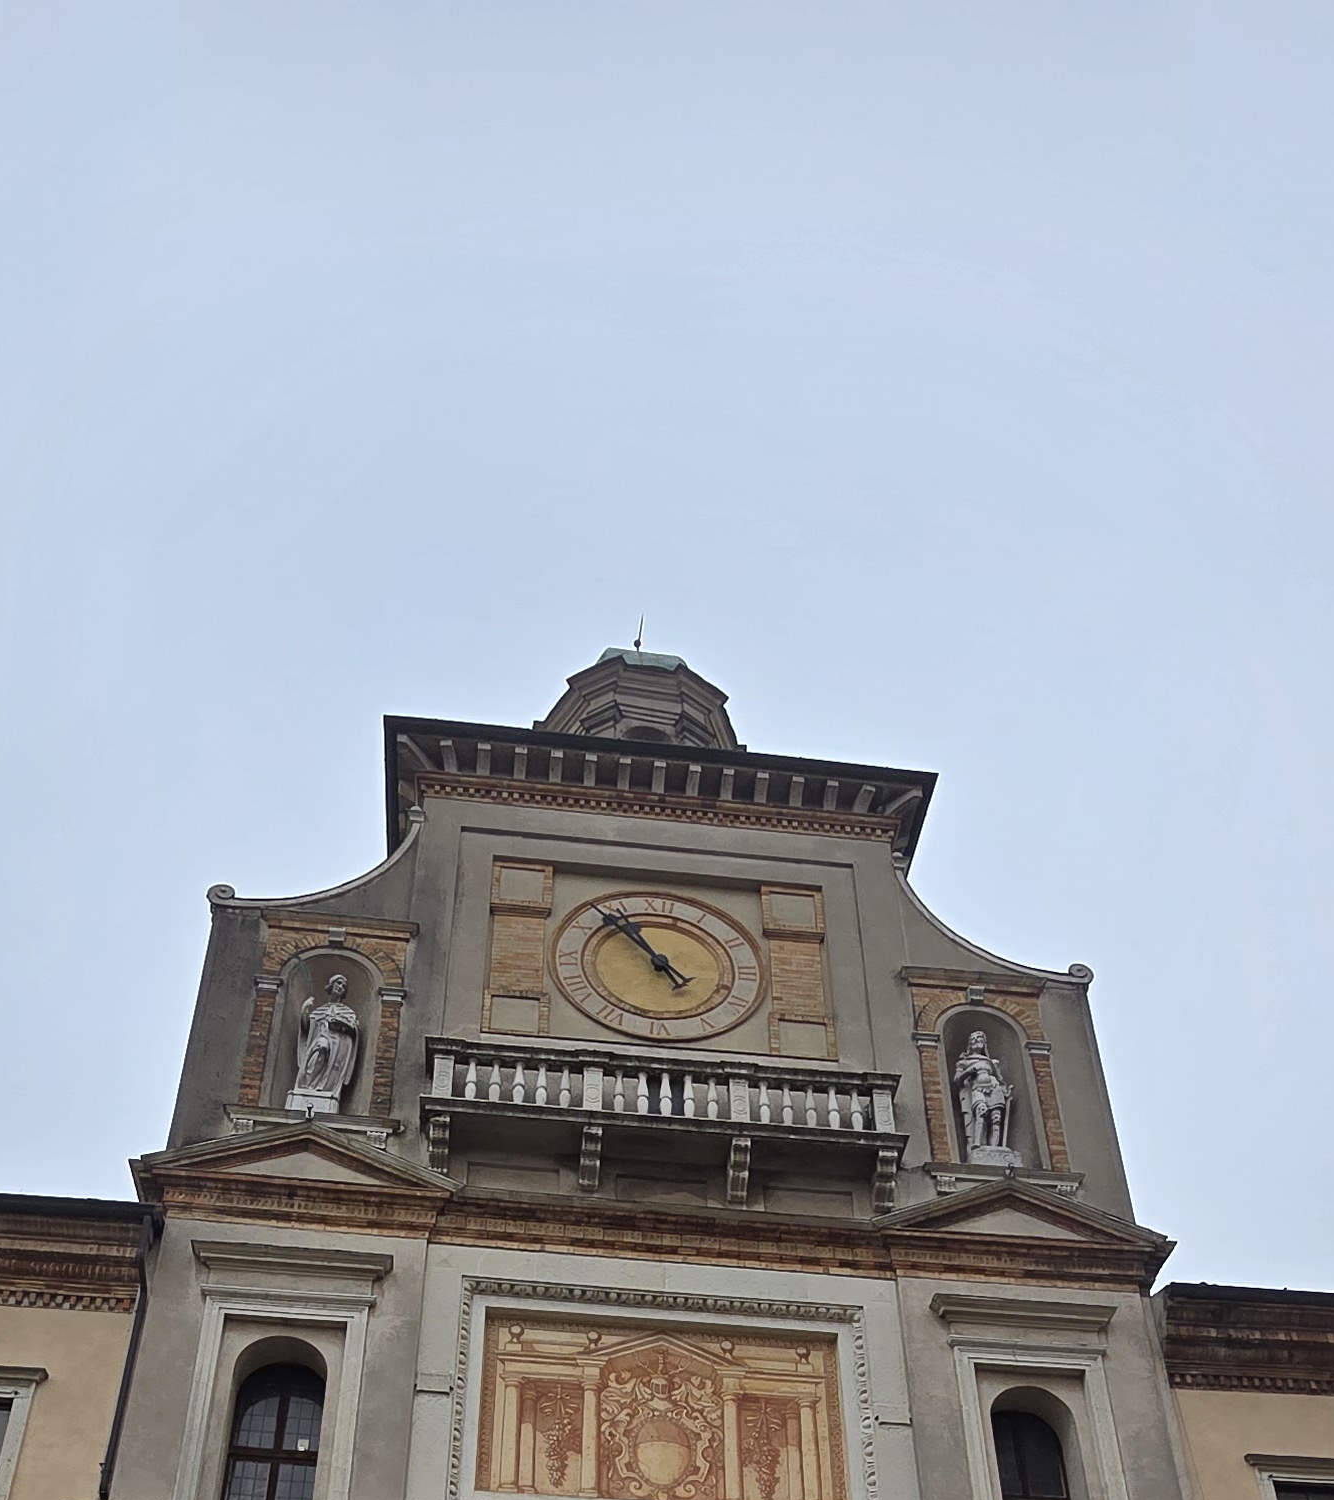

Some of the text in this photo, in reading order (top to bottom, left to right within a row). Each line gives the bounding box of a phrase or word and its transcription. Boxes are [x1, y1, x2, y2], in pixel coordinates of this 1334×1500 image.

[645, 899, 675, 914] XII
[697, 913, 707, 924] I
[570, 920, 593, 936] X
[723, 936, 745, 949] II
[559, 949, 578, 966] IX
[738, 965, 757, 981] III
[564, 974, 592, 1003] VIII
[727, 994, 749, 1015] IV
[596, 1004, 624, 1026] VII
[649, 1021, 671, 1036] VI
[700, 1016, 716, 1031] V
